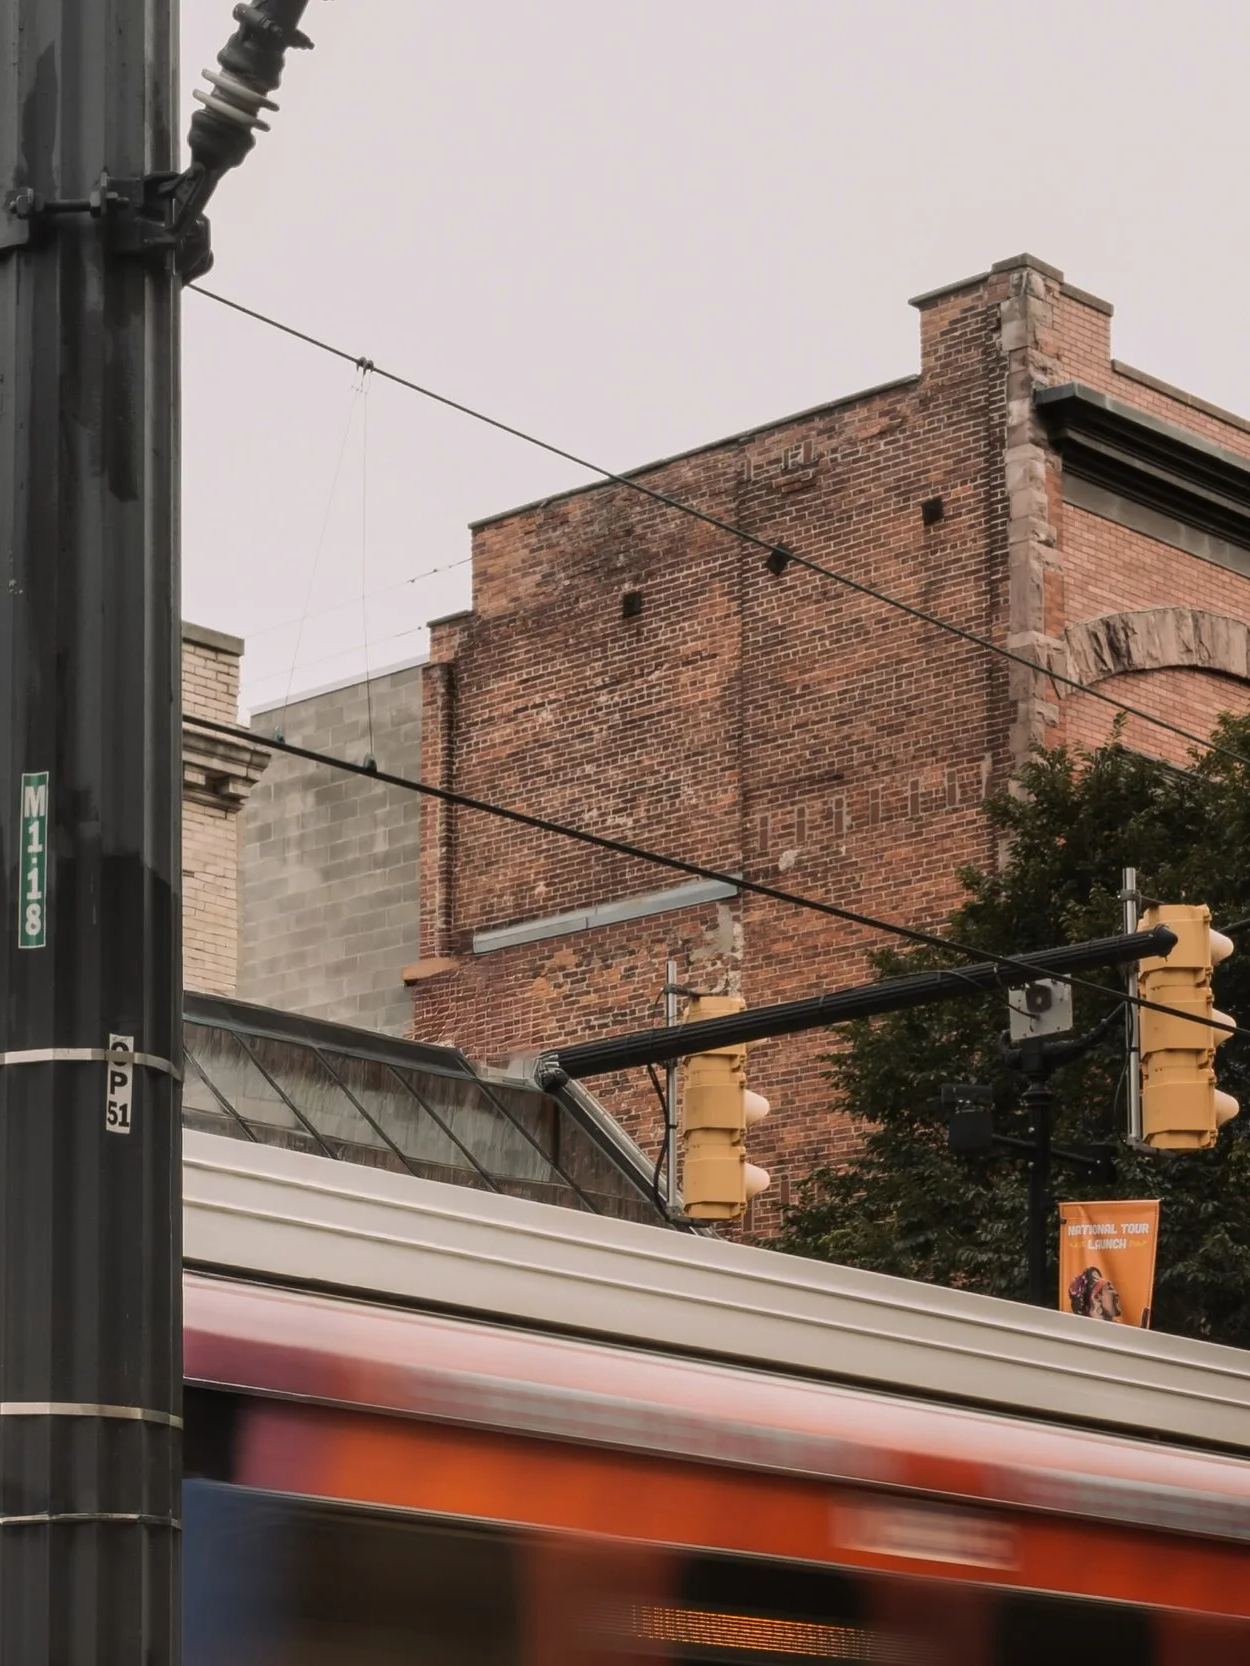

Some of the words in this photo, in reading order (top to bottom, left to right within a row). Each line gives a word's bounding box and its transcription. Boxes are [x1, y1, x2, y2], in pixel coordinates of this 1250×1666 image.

[1068, 1223, 1117, 1236] NATIONAL
[1121, 1223, 1149, 1234] TOUR
[1087, 1238, 1126, 1250] LAUNCH
